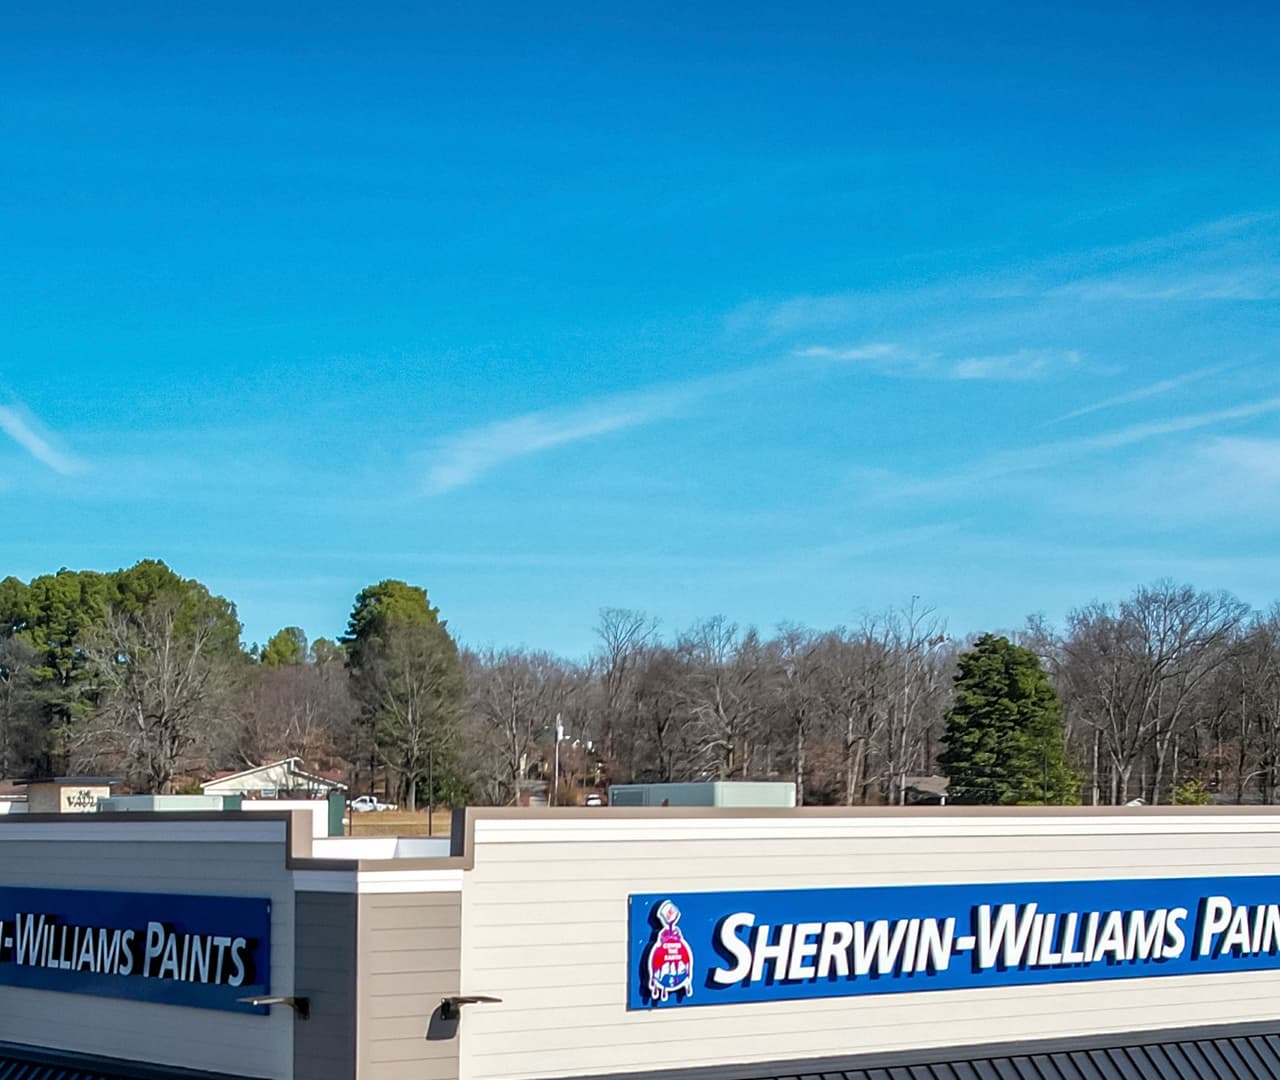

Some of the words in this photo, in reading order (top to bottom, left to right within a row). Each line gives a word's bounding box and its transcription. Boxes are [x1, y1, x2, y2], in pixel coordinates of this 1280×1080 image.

[66, 796, 97, 808] VAUL
[143, 921, 247, 987] PAINTS
[714, 900, 1188, 984] SHERWIN-WILLIAMS
